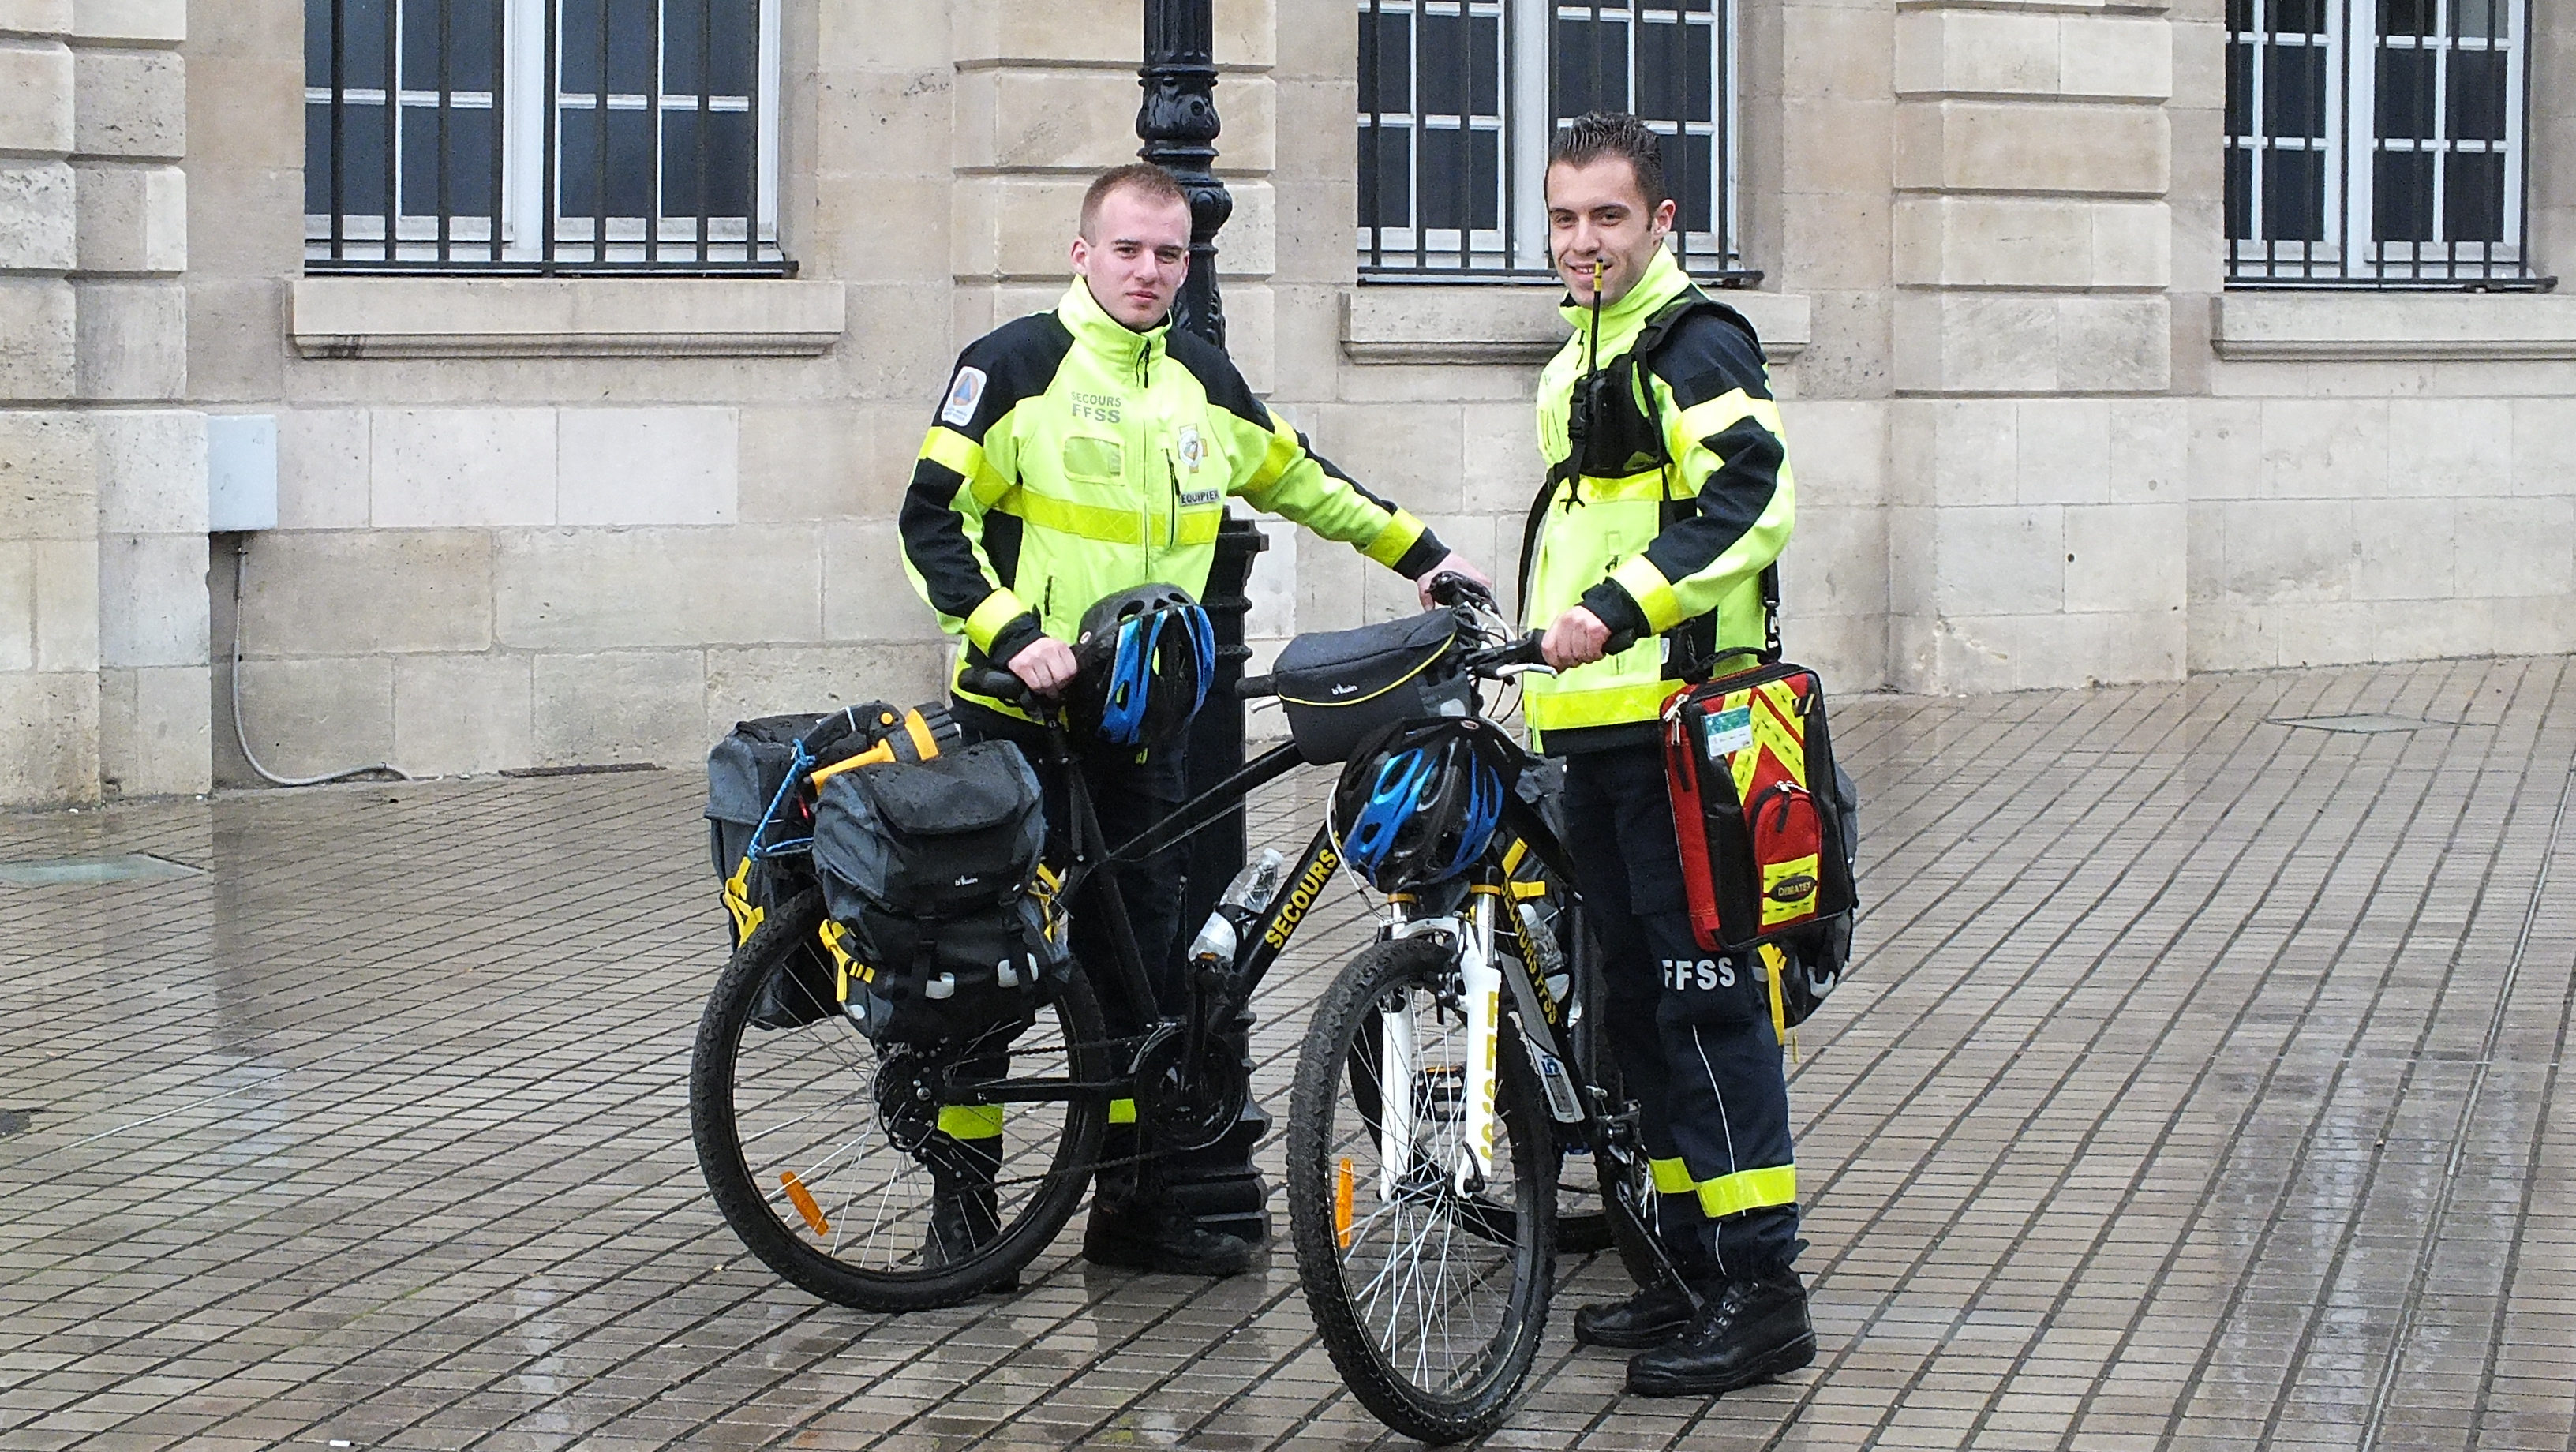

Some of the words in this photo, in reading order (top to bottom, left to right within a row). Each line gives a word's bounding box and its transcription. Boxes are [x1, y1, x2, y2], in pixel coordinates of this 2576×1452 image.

[1071, 391, 1121, 407] SECOURS
[1072, 403, 1121, 424] FFSS
[1265, 849, 1338, 949] SECOURS
[1501, 878, 1537, 975] SECOURS
[1535, 973, 1557, 1025] FFSS
[1661, 957, 1735, 990] FFSS
